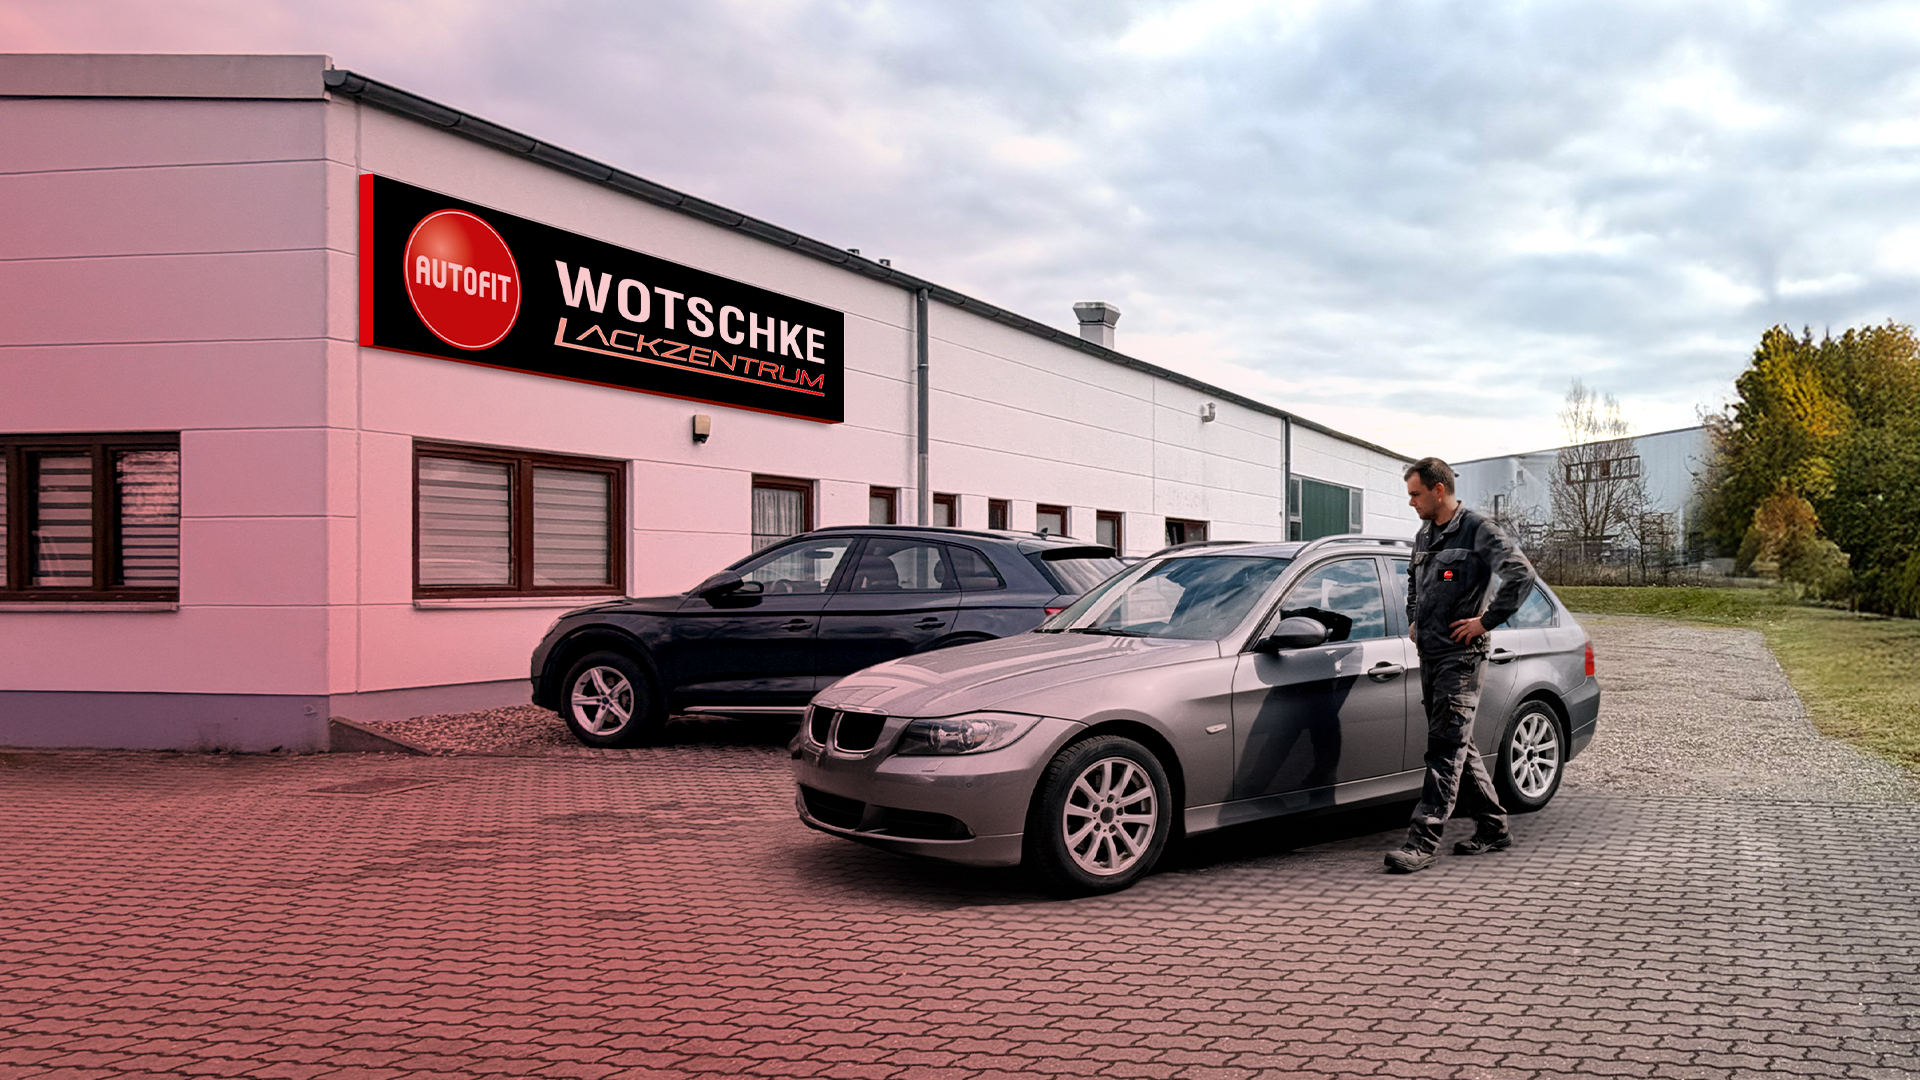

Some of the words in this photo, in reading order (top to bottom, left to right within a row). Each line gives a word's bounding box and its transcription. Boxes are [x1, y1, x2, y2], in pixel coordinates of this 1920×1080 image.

[416, 255, 511, 303] AUTOFIT
[555, 260, 825, 364] WOTSCHKE
[554, 317, 825, 394] LACKZENTRUM
